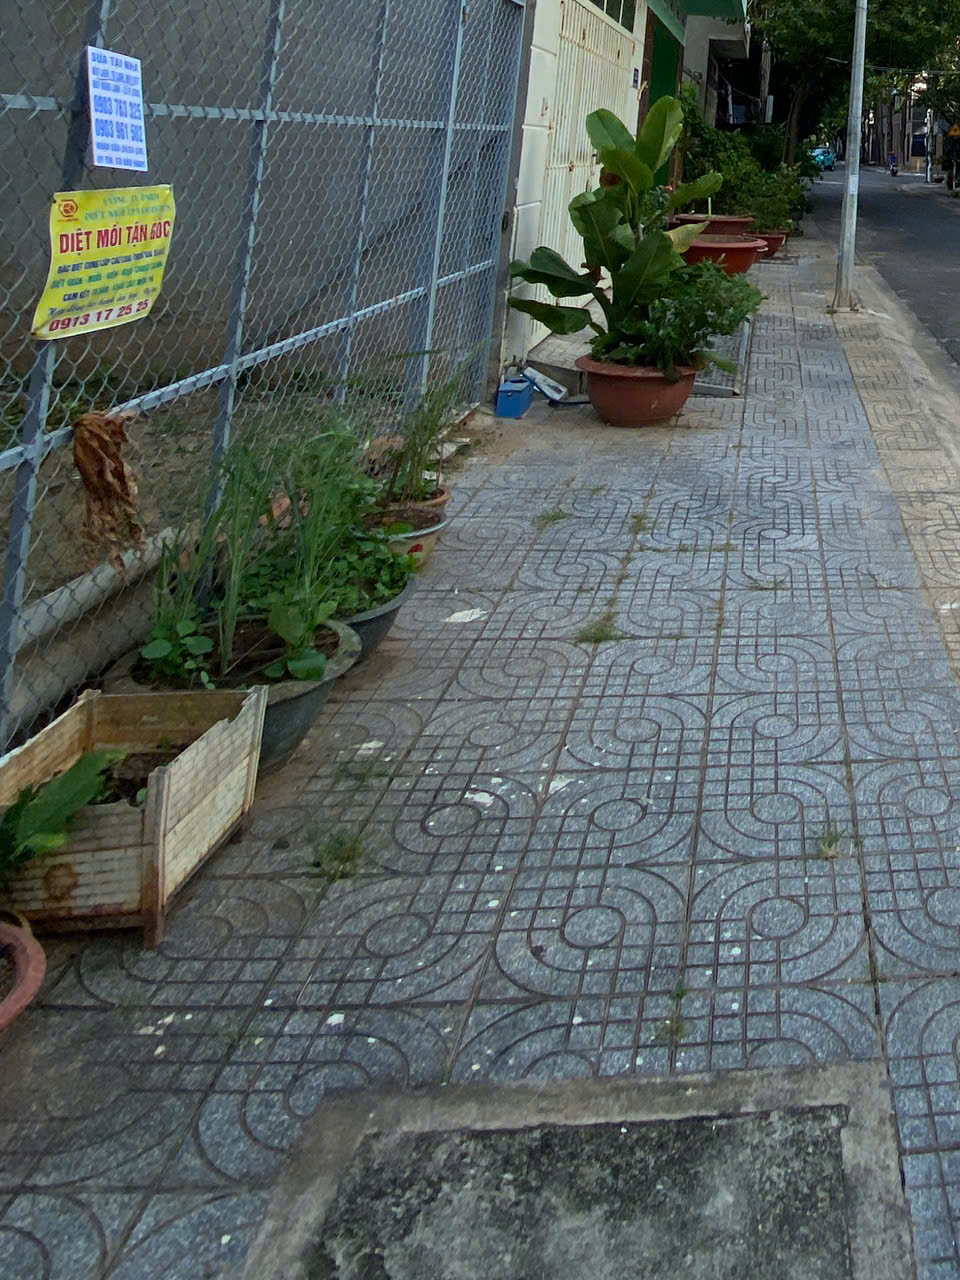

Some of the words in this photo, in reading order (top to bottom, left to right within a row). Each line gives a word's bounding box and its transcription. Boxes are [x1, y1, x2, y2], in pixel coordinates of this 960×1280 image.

[59, 228, 92, 256] DIỆT
[97, 222, 122, 249] MỐI
[126, 222, 148, 247] TẬN
[150, 218, 172, 241] GỐC
[49, 313, 91, 332] 0913
[95, 308, 114, 322] 17
[117, 303, 132, 317] 25
[136, 299, 149, 312] 25
